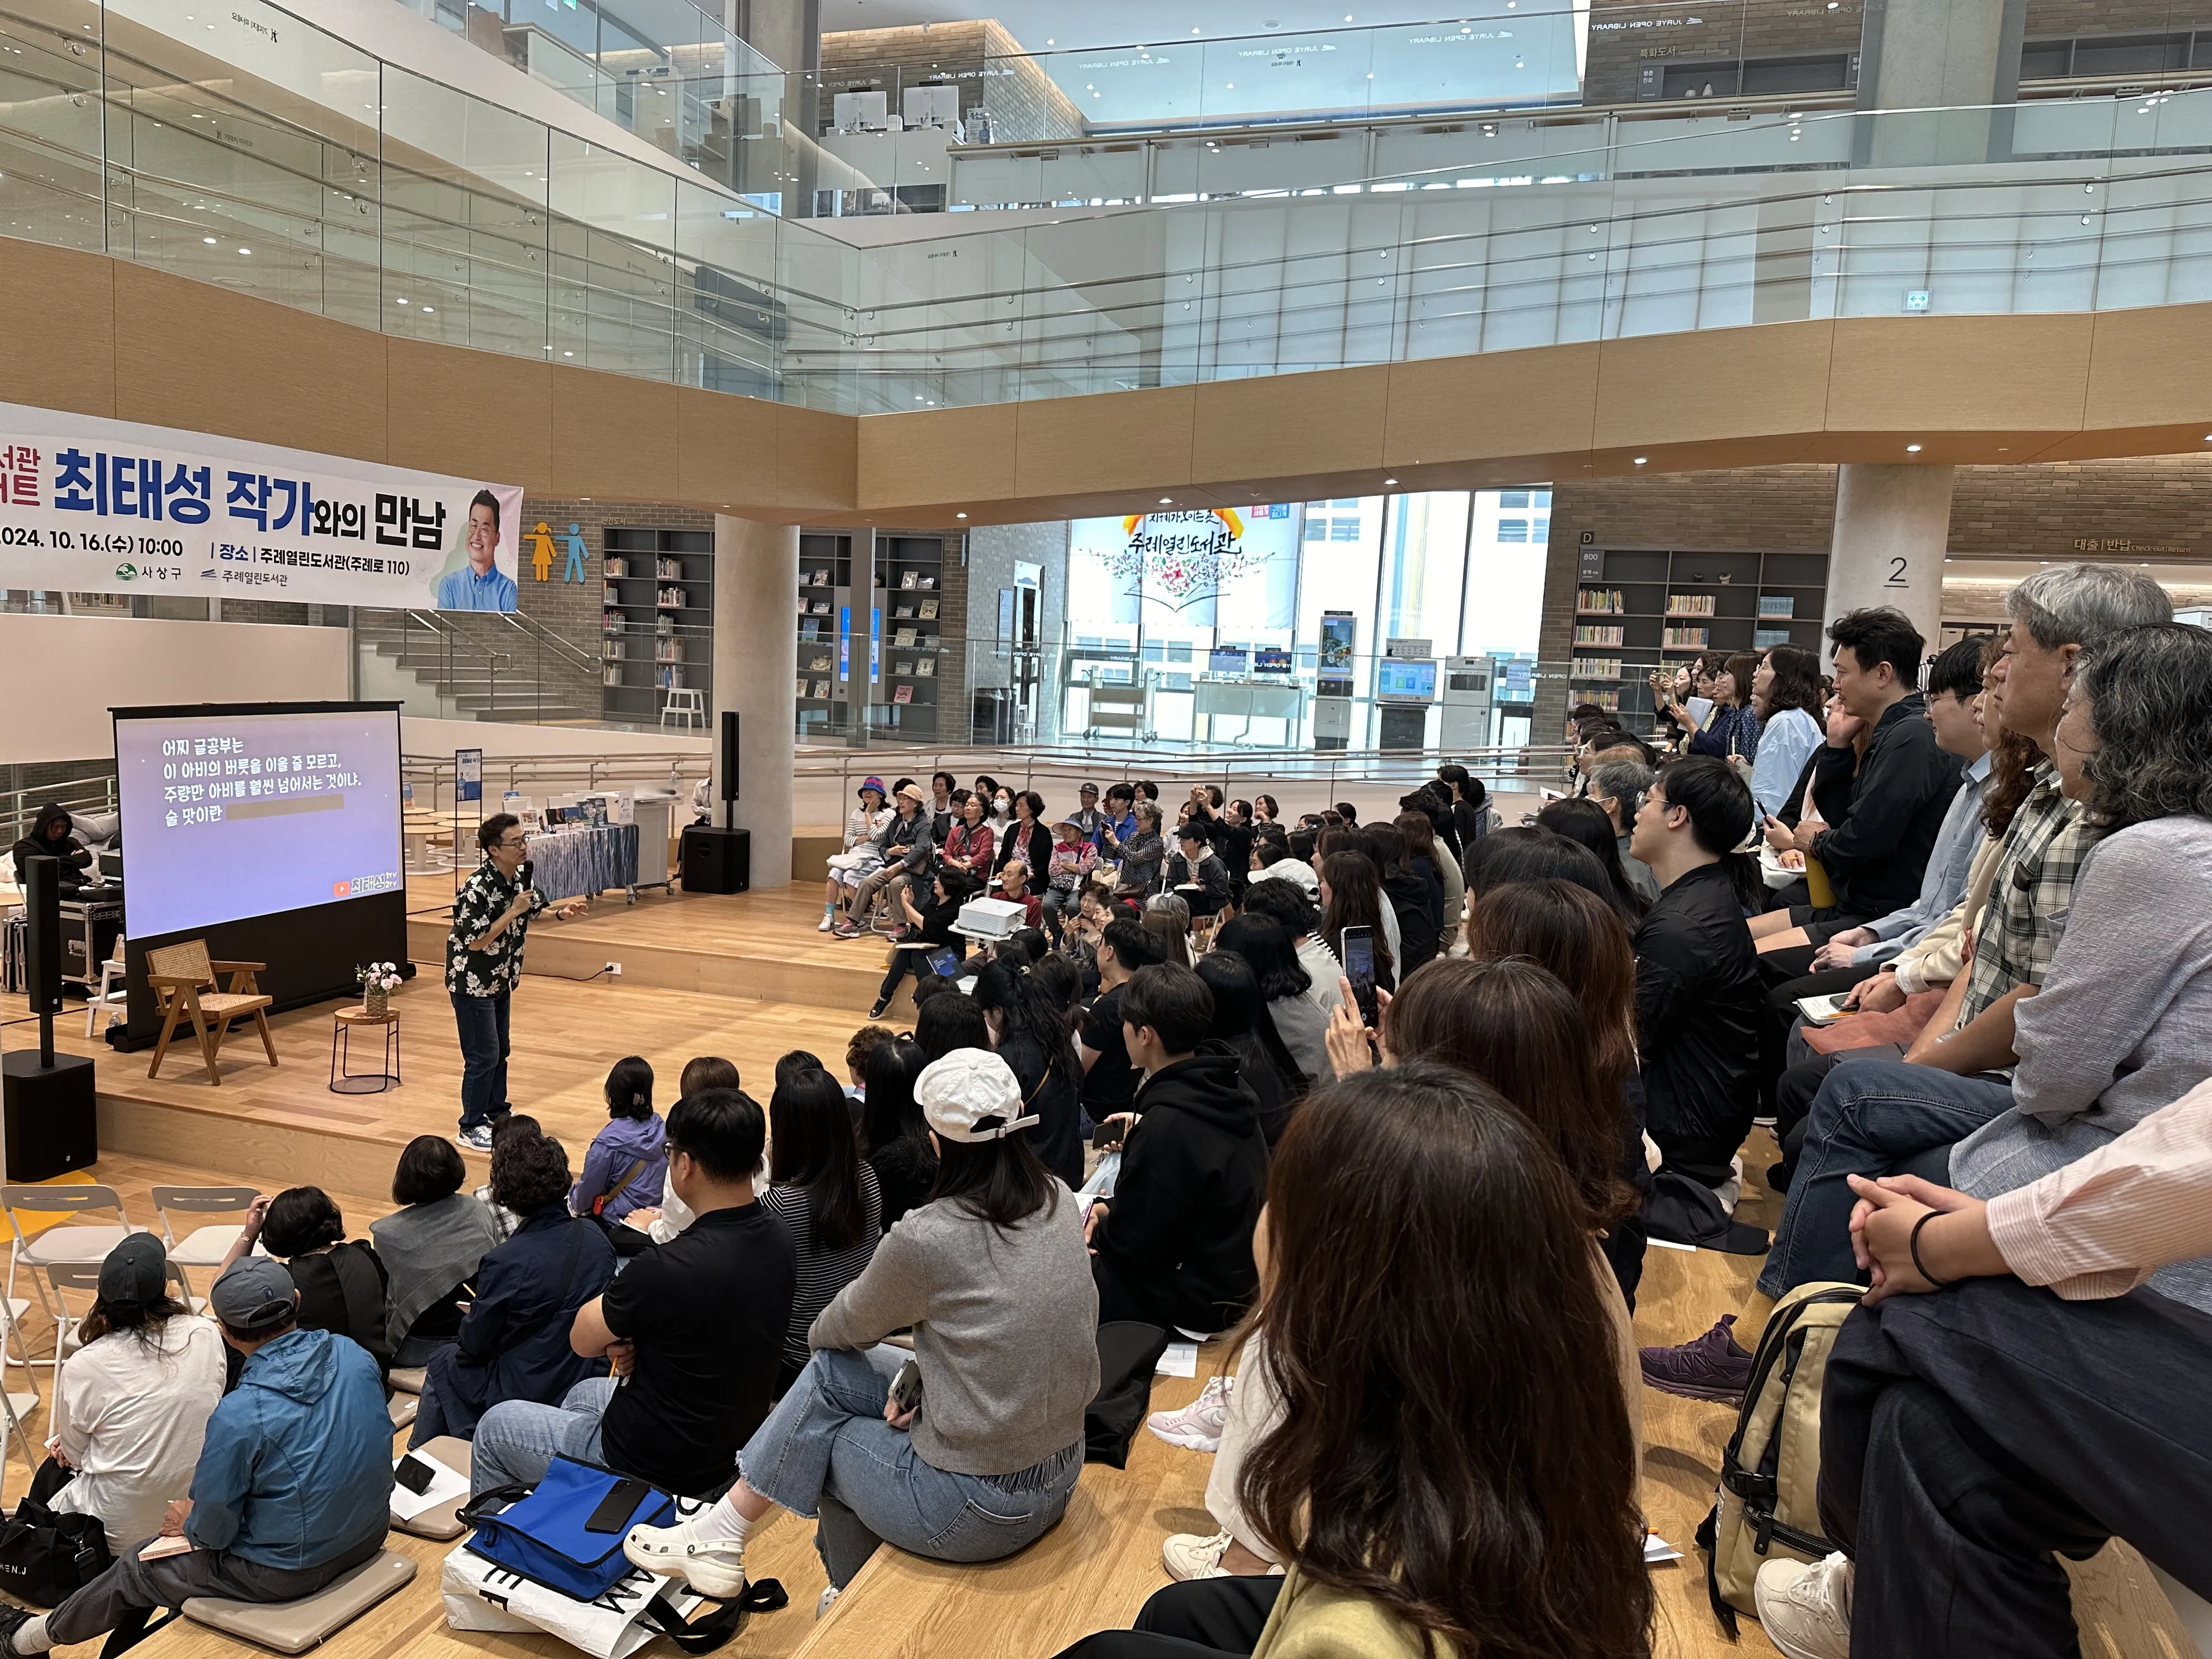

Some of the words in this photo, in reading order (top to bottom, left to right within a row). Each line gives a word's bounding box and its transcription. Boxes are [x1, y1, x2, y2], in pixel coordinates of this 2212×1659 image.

[1640, 46, 1676, 58] 특화도서
[55, 447, 211, 525] 최태성
[226, 470, 366, 541] 작가와의
[375, 493, 446, 551] 만남
[0, 526, 44, 547] 024.
[50, 530, 75, 549] 10.
[80, 533, 134, 554] 16.(수)
[139, 538, 183, 557] 10:00
[1128, 531, 1242, 556] 주례열린도서관
[1583, 533, 1592, 543] D
[2074, 538, 2099, 551] 대출
[2107, 539, 2132, 552] 반납
[220, 544, 248, 562] 장소
[387, 560, 410, 576] 110)
[1888, 557, 1907, 582] 2
[222, 570, 288, 587] 주례열린도서관
[163, 739, 189, 757] 어찌
[194, 737, 244, 756] 글공부는
[164, 763, 176, 780] 이
[181, 760, 221, 779] 아비의
[225, 758, 262, 775] 버릇을
[265, 756, 289, 773] 이을
[292, 755, 303, 771] 줄
[306, 753, 341, 770] 모르고,
[164, 784, 205, 804] 주량만
[208, 780, 247, 799] 아비를
[249, 778, 274, 796] 훨씬
[278, 775, 323, 794] 넘어서는
[325, 772, 362, 790] 것이냐.
[165, 809, 179, 827] 술
[182, 805, 222, 826] 맛이란
[351, 874, 385, 895] 최태성
